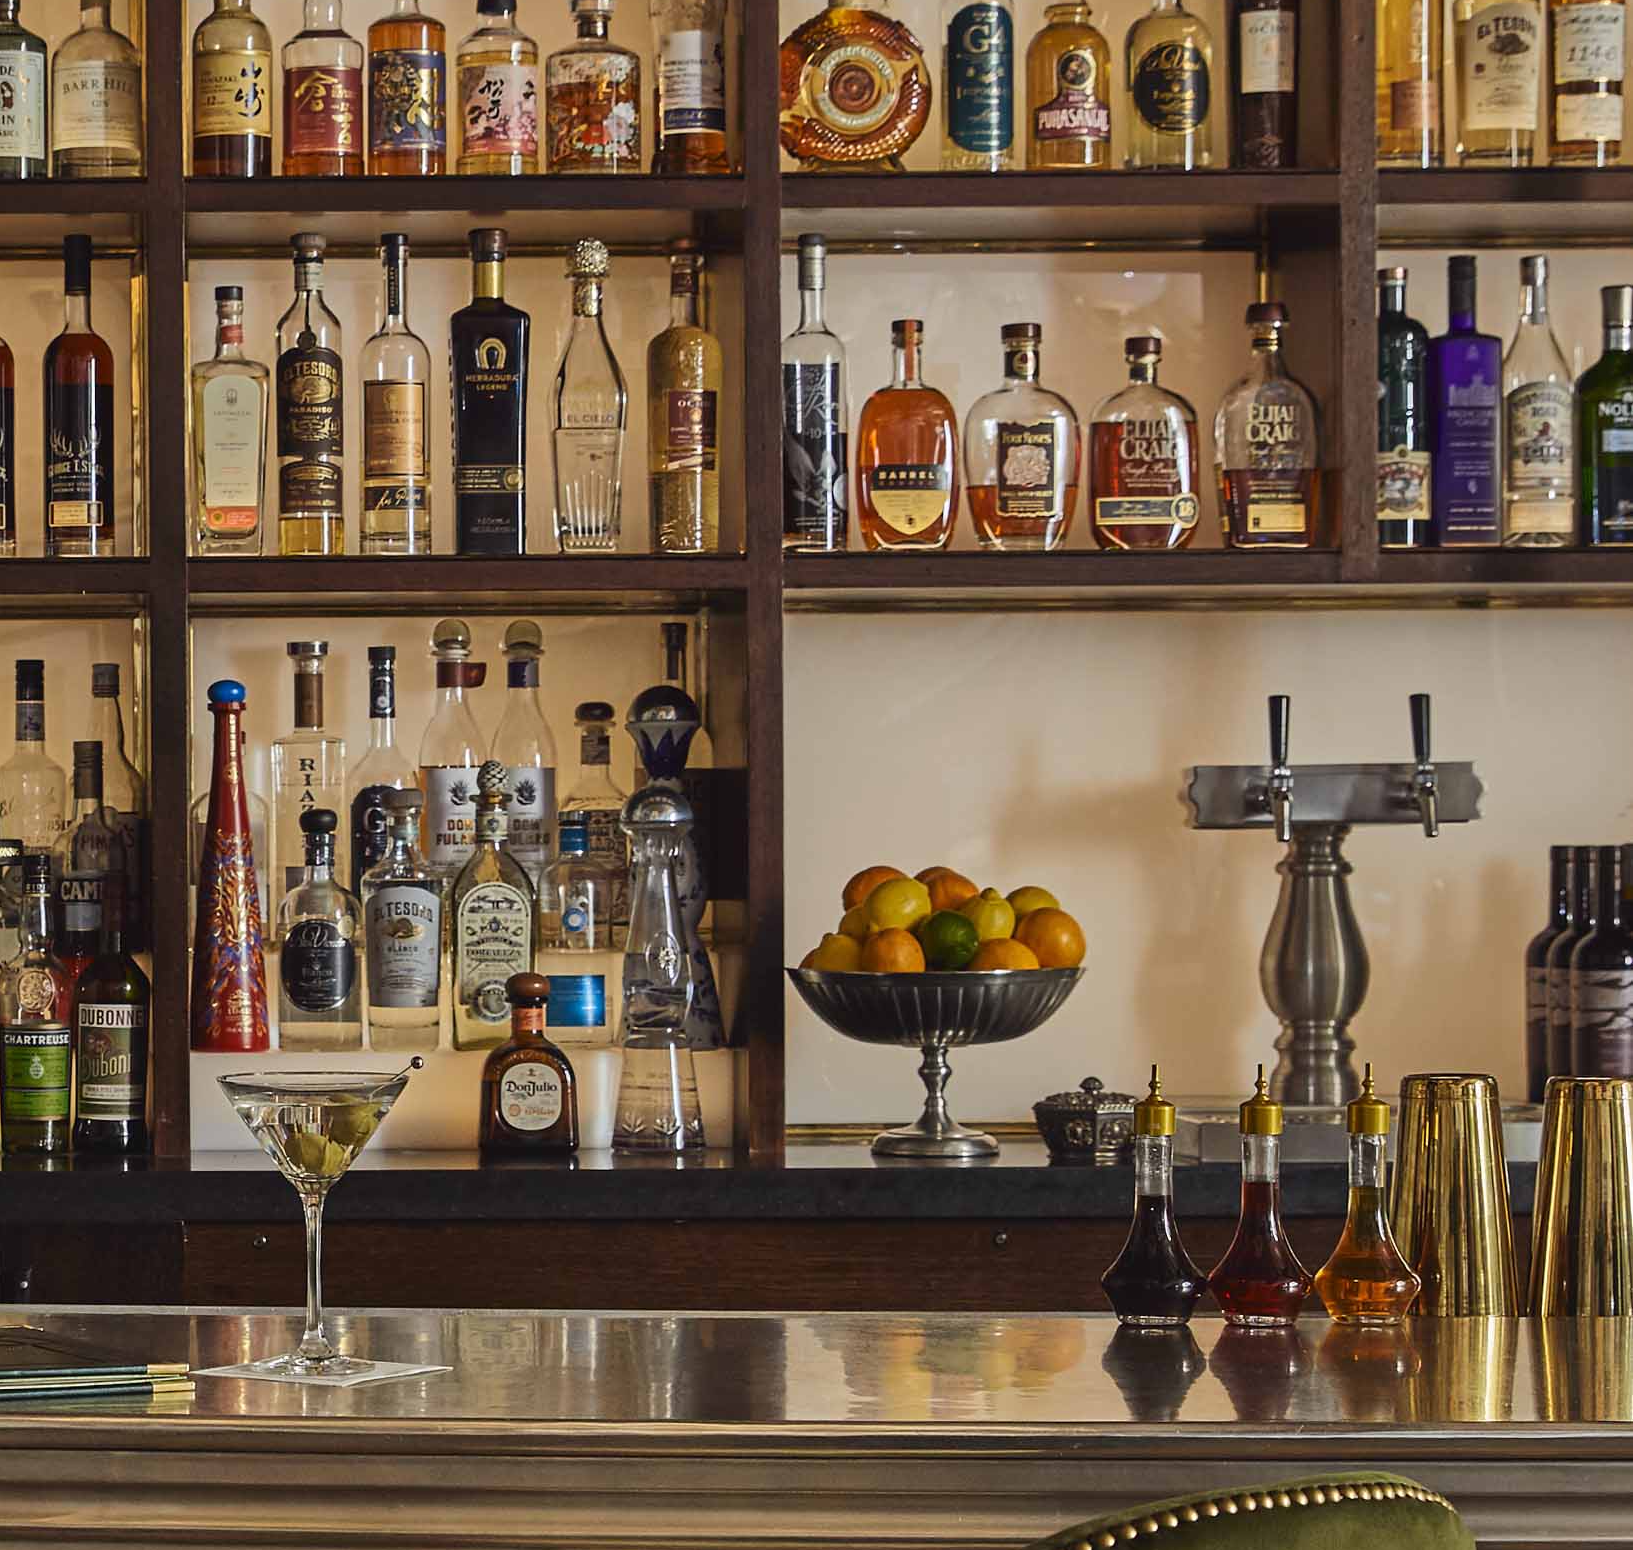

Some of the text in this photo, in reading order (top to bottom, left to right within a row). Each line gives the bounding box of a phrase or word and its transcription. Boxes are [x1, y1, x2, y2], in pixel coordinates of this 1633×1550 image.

[62, 79, 101, 95] BARR
[234, 61, 266, 118] 山崎
[294, 361, 338, 378] TESORO
[465, 374, 518, 383] HERRADURA
[567, 414, 615, 424] EL CIELO
[1245, 423, 1298, 444] CRAIG
[1120, 439, 1178, 461] CRAIG
[513, 819, 540, 831] DON
[509, 832, 551, 845] ULANO
[386, 901, 434, 923] TESORO
[80, 1008, 143, 1027] DUBONNE
[4, 1033, 70, 1045] CHARTREUSE
[505, 1081, 558, 1097] Don Julio
